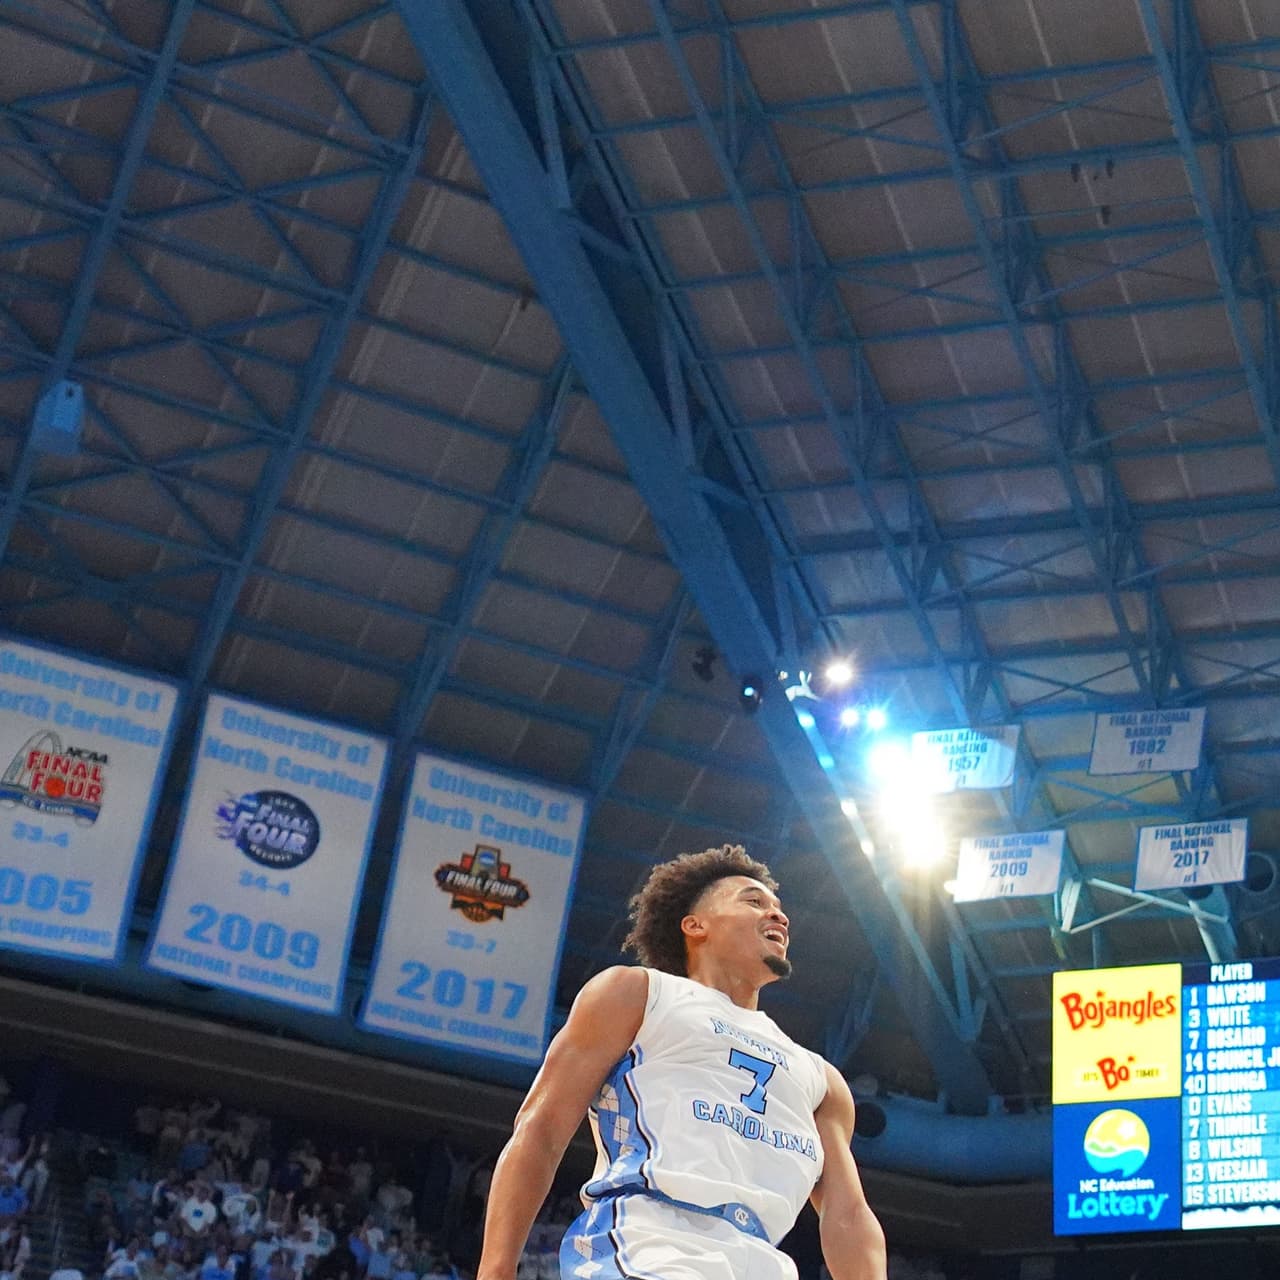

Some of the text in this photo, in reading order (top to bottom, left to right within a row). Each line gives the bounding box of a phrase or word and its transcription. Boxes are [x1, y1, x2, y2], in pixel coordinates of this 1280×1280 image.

[222, 706, 341, 761] University
[26, 750, 103, 781] FINAL
[205, 734, 374, 801] North Carolina
[429, 766, 543, 818] University
[257, 804, 310, 830] FINAL
[412, 796, 574, 857] North Carolina
[236, 812, 307, 855] FOUR
[990, 861, 1028, 877] 2009
[1173, 851, 1209, 868] 2017
[184, 902, 321, 969] 2009
[1210, 962, 1253, 982] PLAYER
[397, 958, 528, 1020] 2017
[1207, 981, 1266, 1006] DAWSON
[1060, 991, 1176, 1031] Bojangles
[1207, 1004, 1251, 1027] WHITE
[729, 1047, 777, 1114] 7
[1207, 1092, 1252, 1115] EVANS
[692, 1099, 818, 1162] CAROLINA
[1207, 1136, 1262, 1159] WILSON
[1080, 1177, 1154, 1194] NC Education
[1068, 1190, 1168, 1221] Lottery
